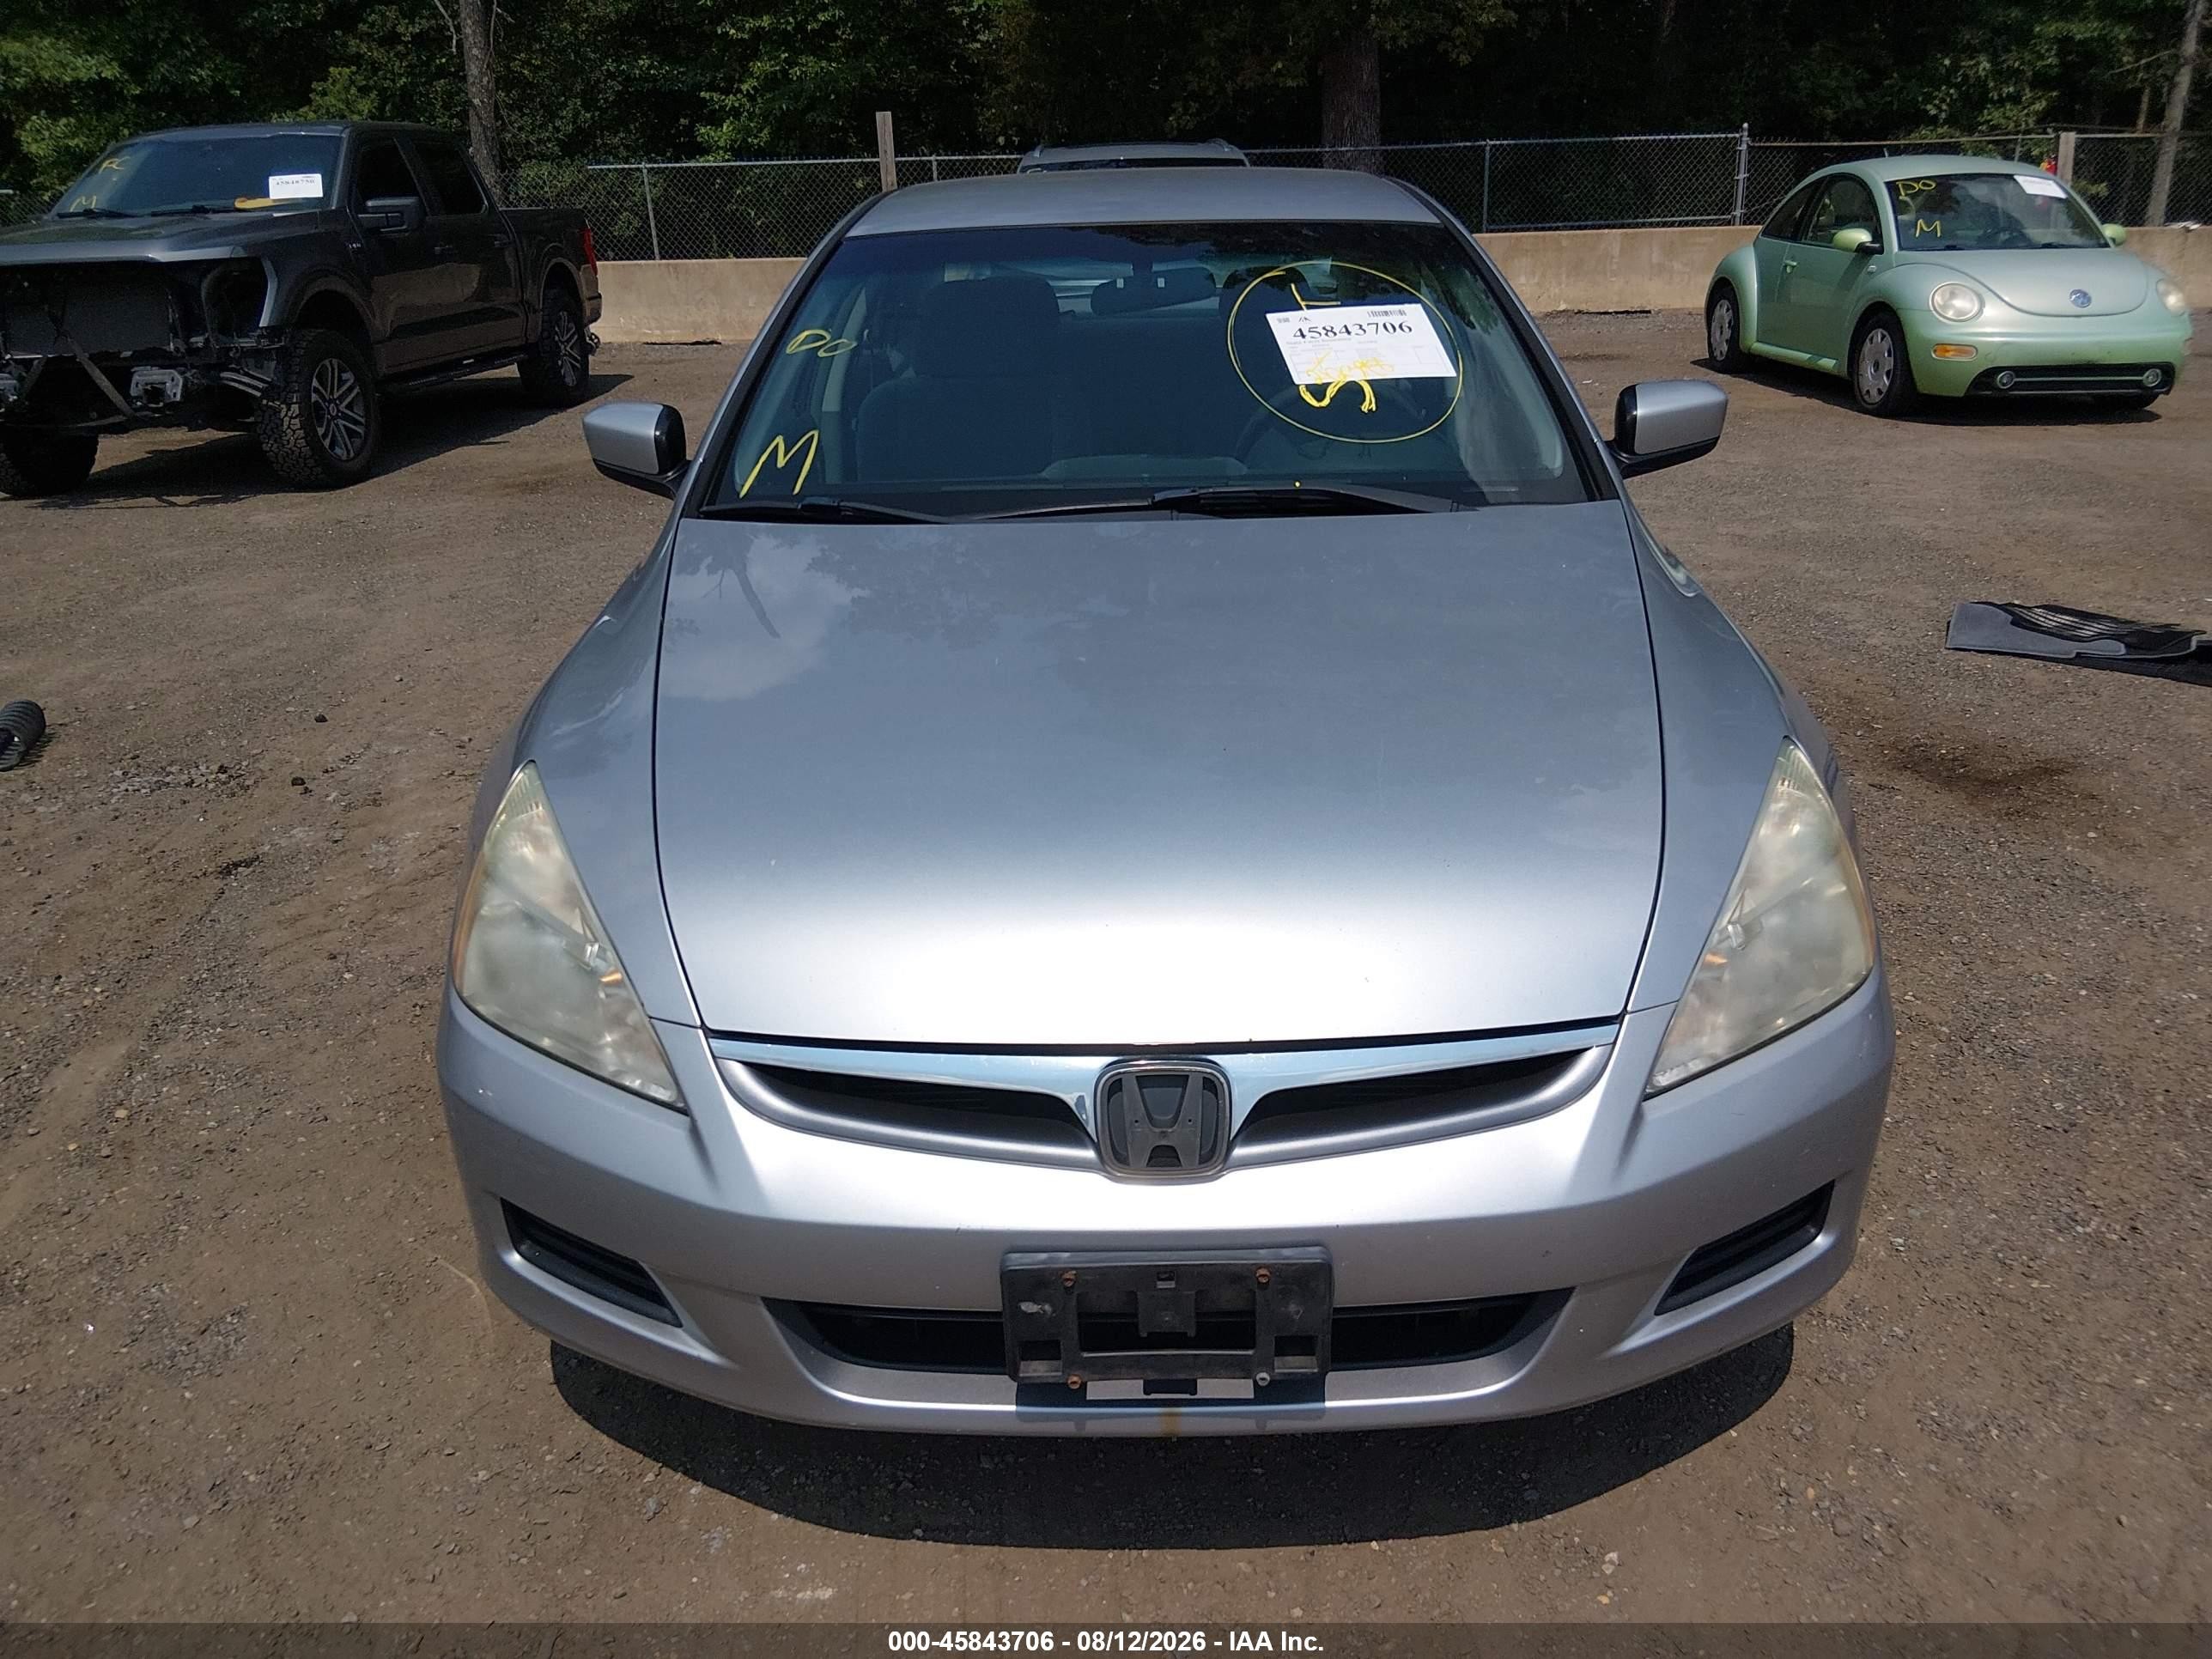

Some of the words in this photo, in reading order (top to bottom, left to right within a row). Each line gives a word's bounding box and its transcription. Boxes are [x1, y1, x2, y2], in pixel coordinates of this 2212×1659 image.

[1915, 218, 1941, 238] M
[1292, 320, 1413, 339] 45843706
[738, 429, 818, 498] M
